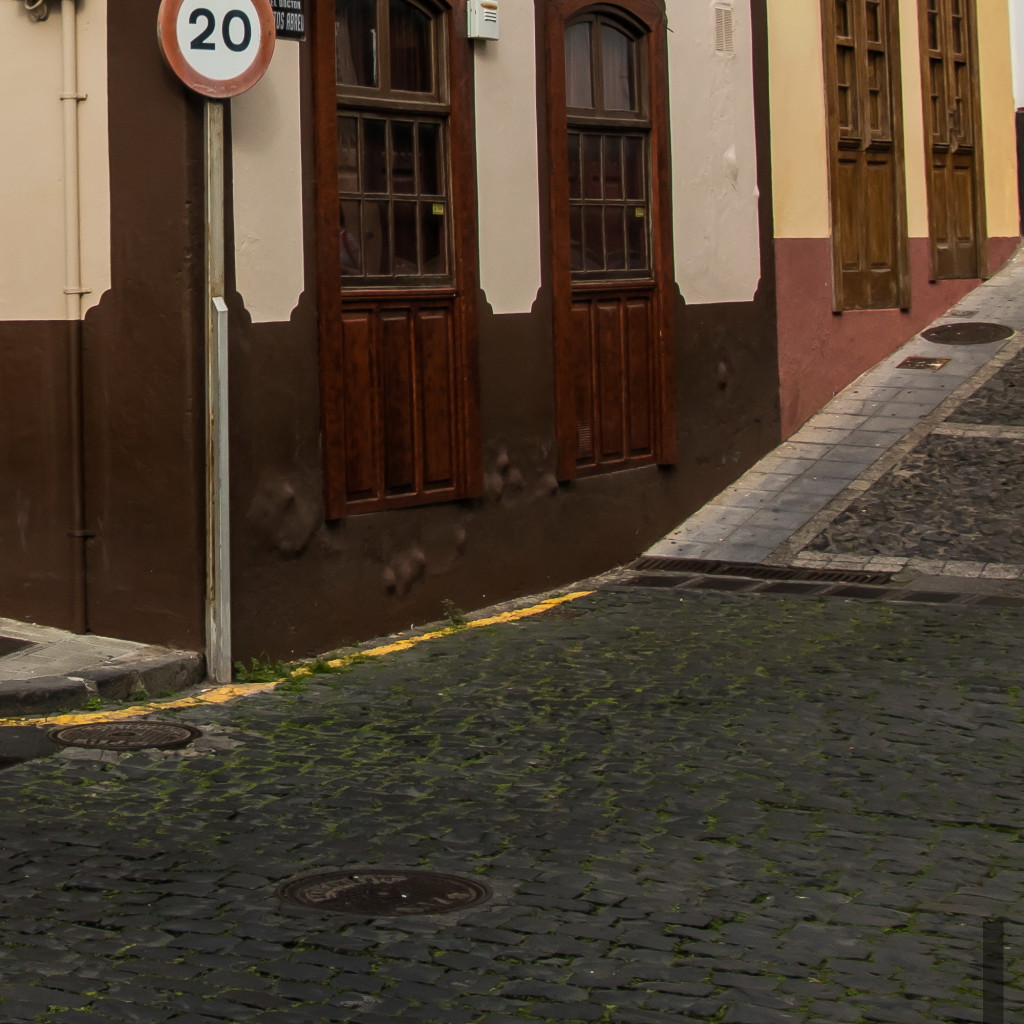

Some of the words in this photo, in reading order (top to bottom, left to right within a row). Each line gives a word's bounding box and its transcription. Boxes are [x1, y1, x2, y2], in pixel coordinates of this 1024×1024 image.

[279, 0, 301, 9] DOCTOR
[188, 7, 252, 53] 20
[286, 12, 305, 32] ABREU
